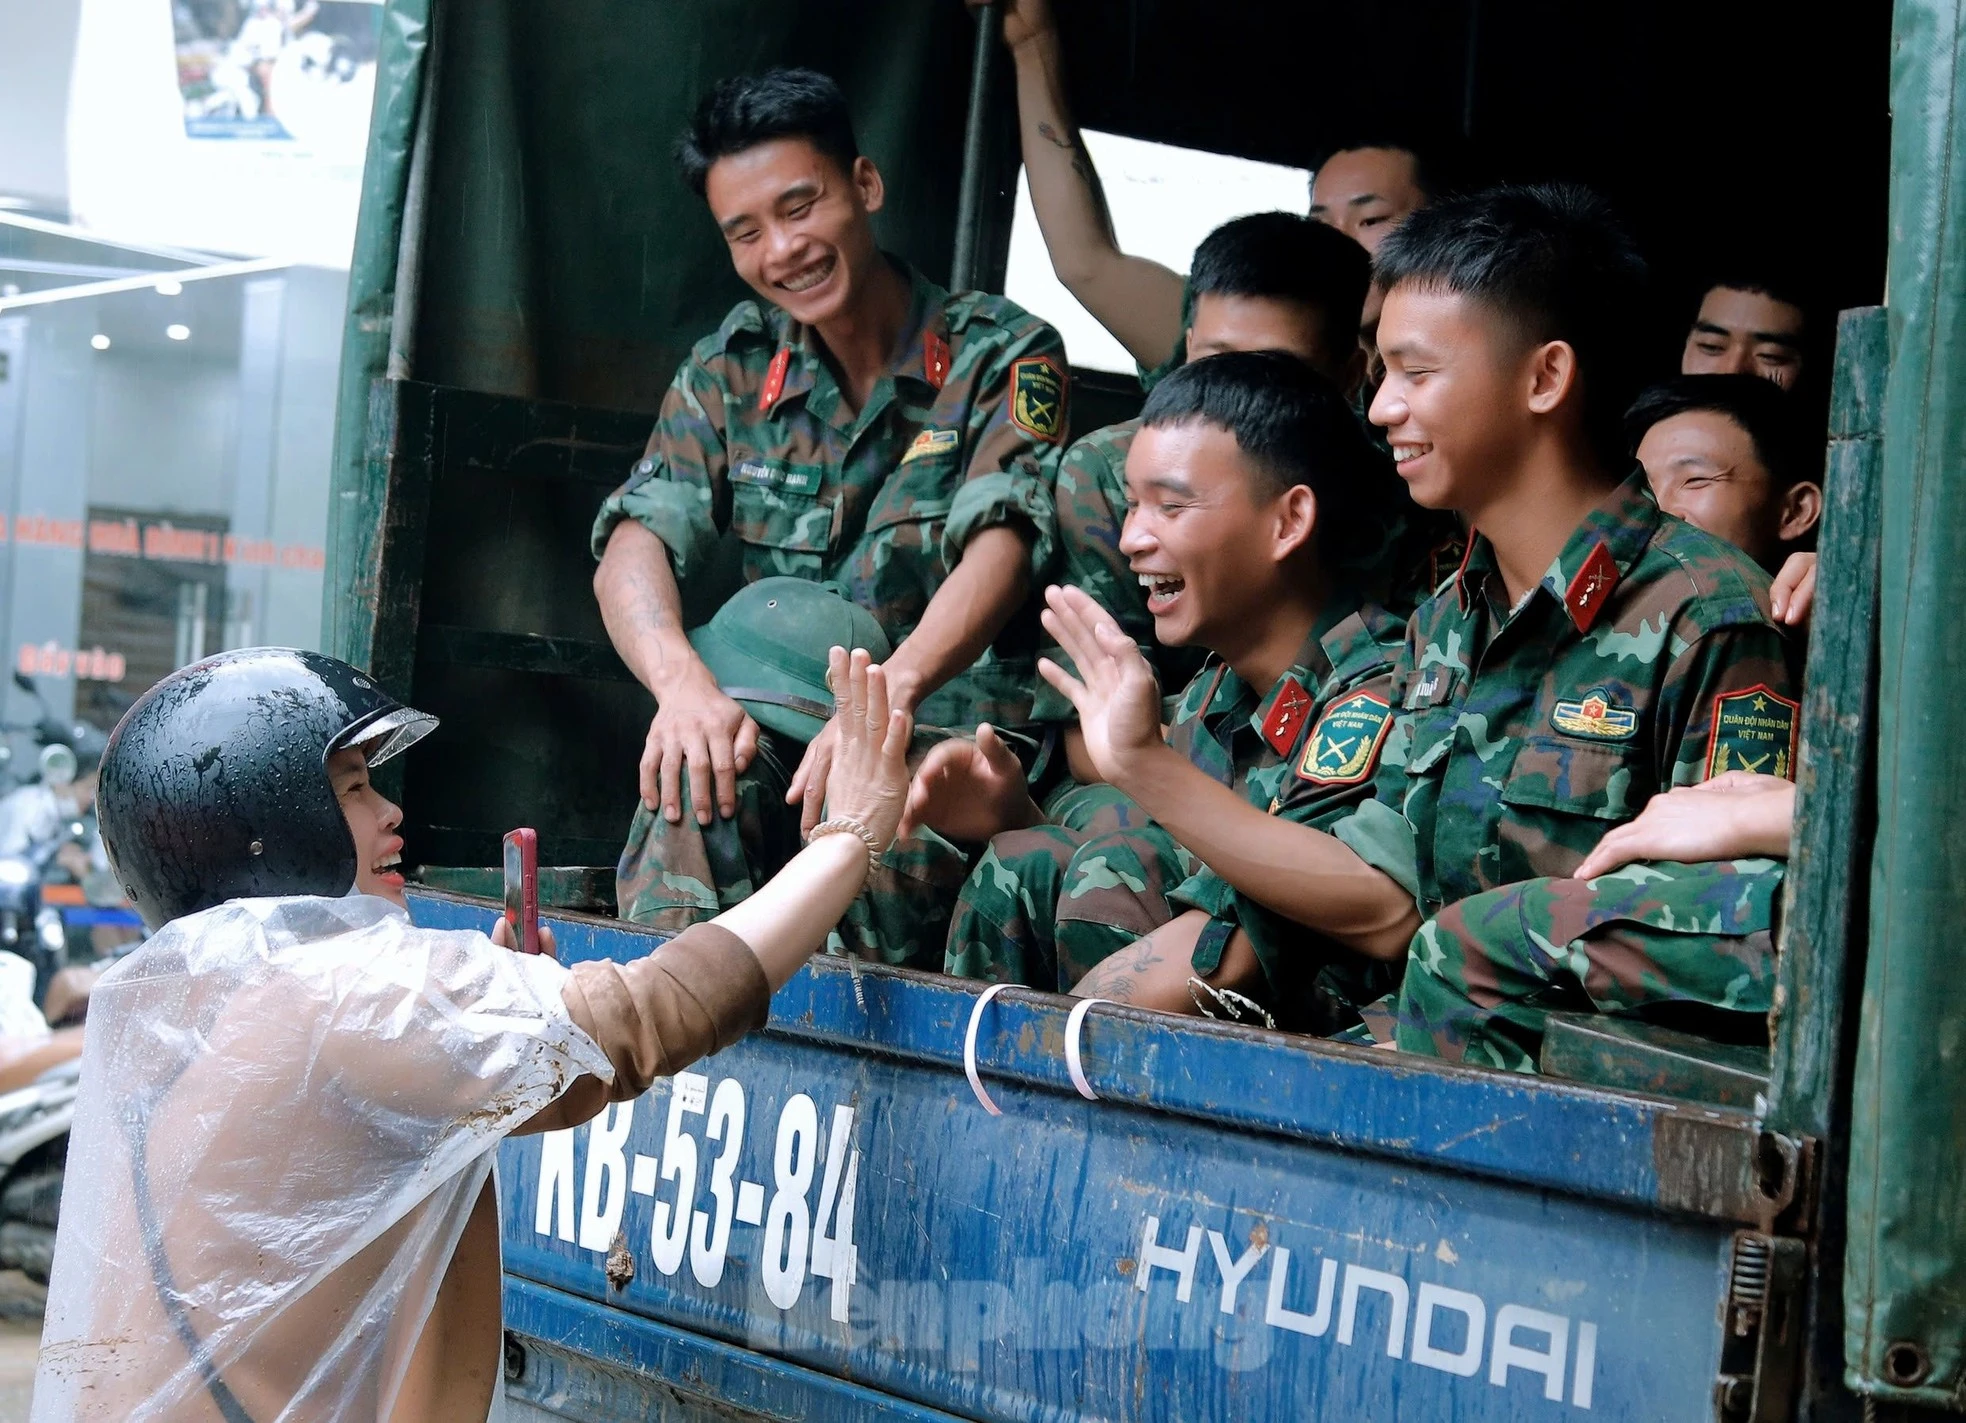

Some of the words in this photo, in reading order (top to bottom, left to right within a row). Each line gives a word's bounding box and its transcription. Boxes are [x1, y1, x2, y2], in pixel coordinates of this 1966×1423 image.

[1723, 714, 1743, 724] QUÂN
[1738, 729, 1756, 740] VIỆT
[1757, 731, 1774, 741] NAM
[1134, 1215, 1598, 1410] HYUNDAI
